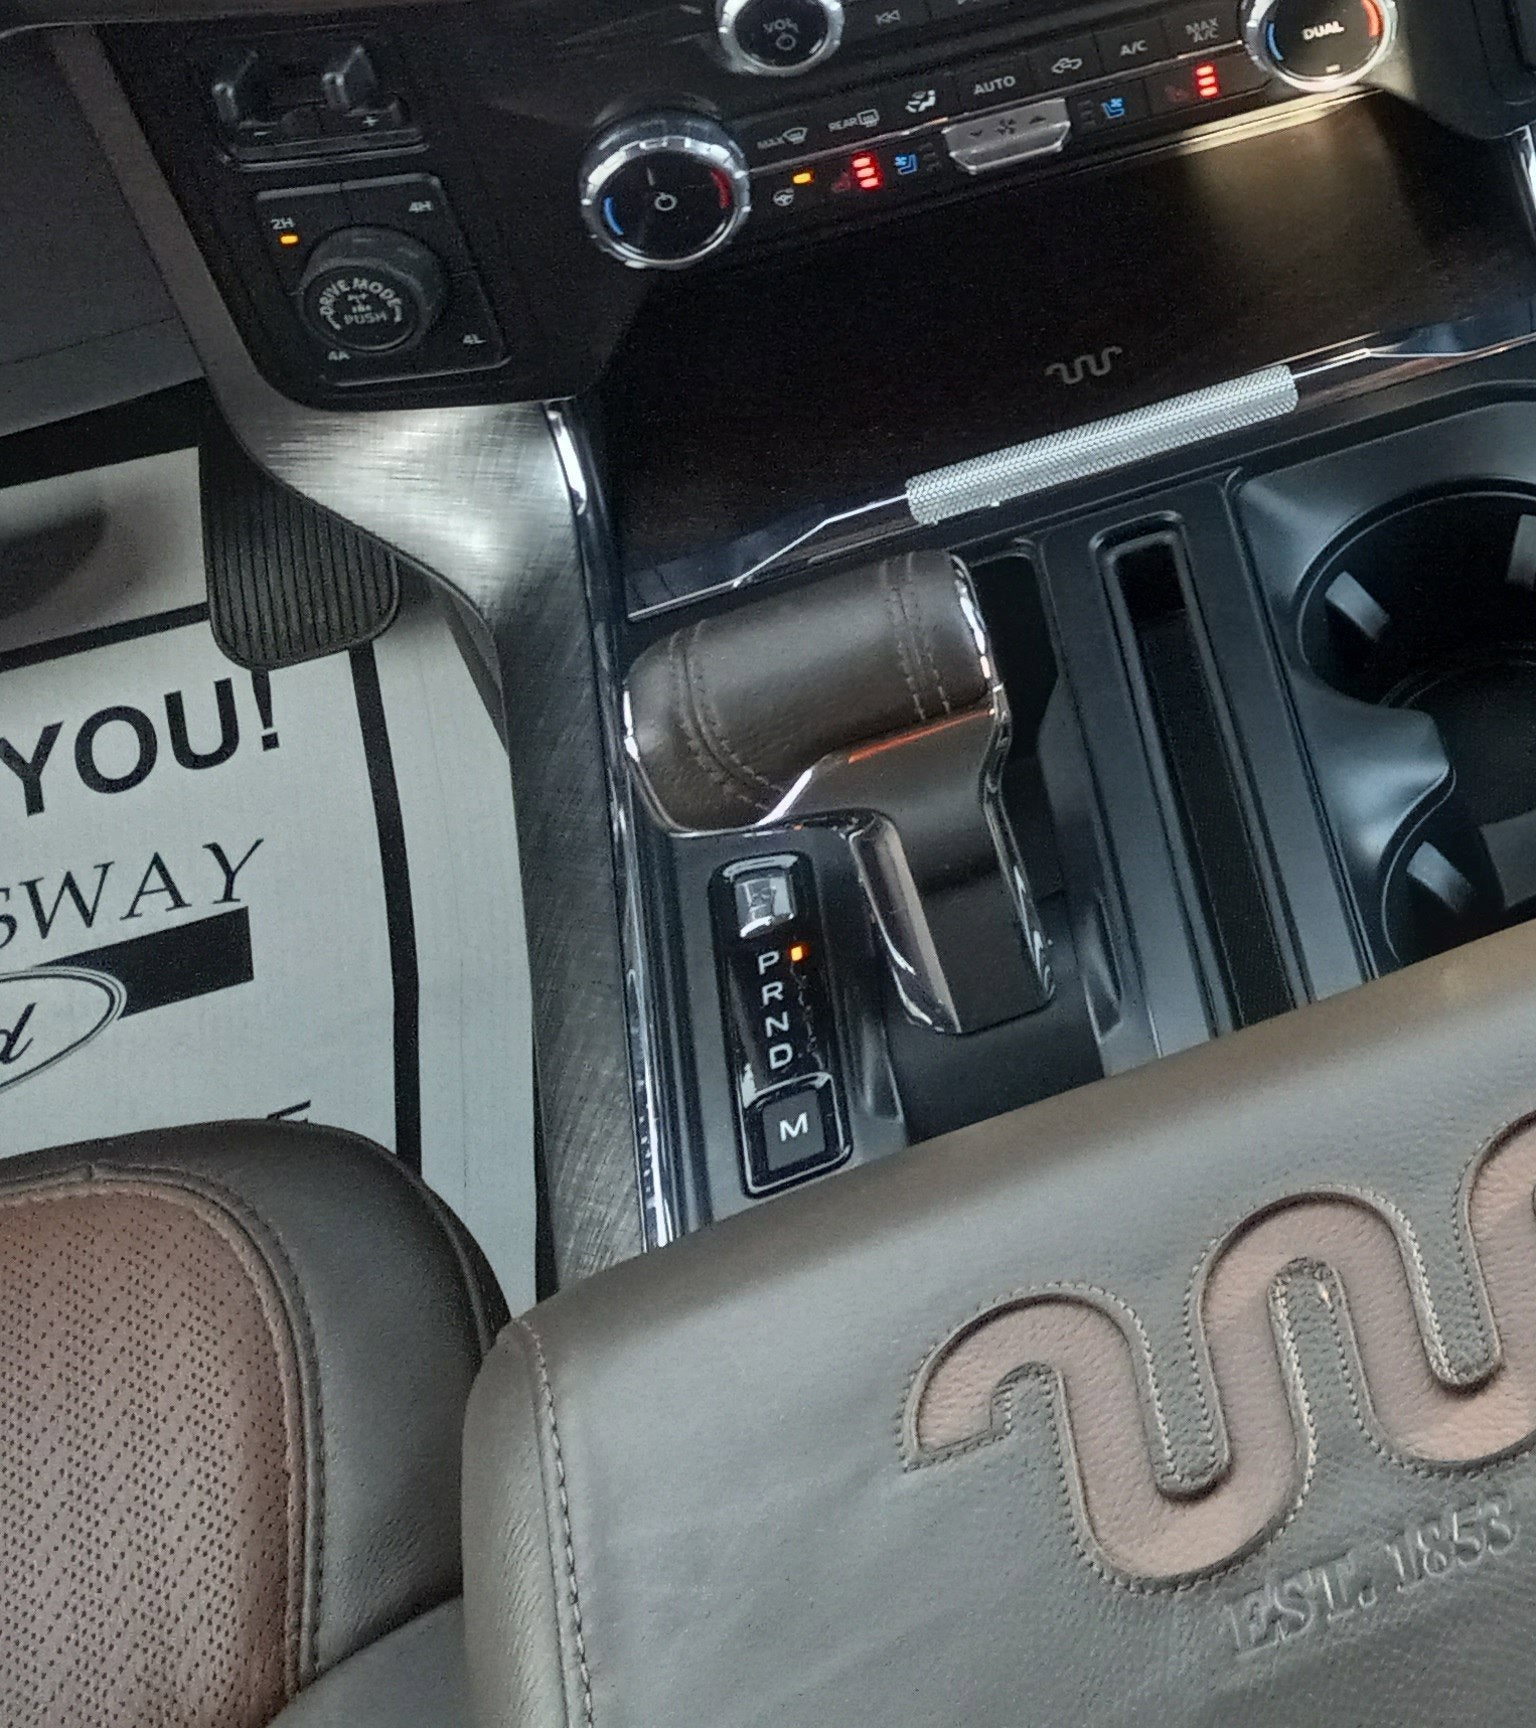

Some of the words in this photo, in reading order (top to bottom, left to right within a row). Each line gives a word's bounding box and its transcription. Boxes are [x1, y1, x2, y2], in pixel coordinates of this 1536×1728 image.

[763, 17, 799, 33] VOL
[1302, 20, 1345, 41] DUAL
[1119, 38, 1149, 57] A/C
[973, 75, 1016, 96] AUTO
[408, 199, 434, 214] 4H
[270, 217, 295, 231] 2H
[0, 670, 280, 817] YOU!
[757, 950, 780, 975] P
[761, 981, 784, 1006] R
[765, 1011, 789, 1038] N
[768, 1043, 793, 1070] D
[778, 1111, 809, 1142] M
